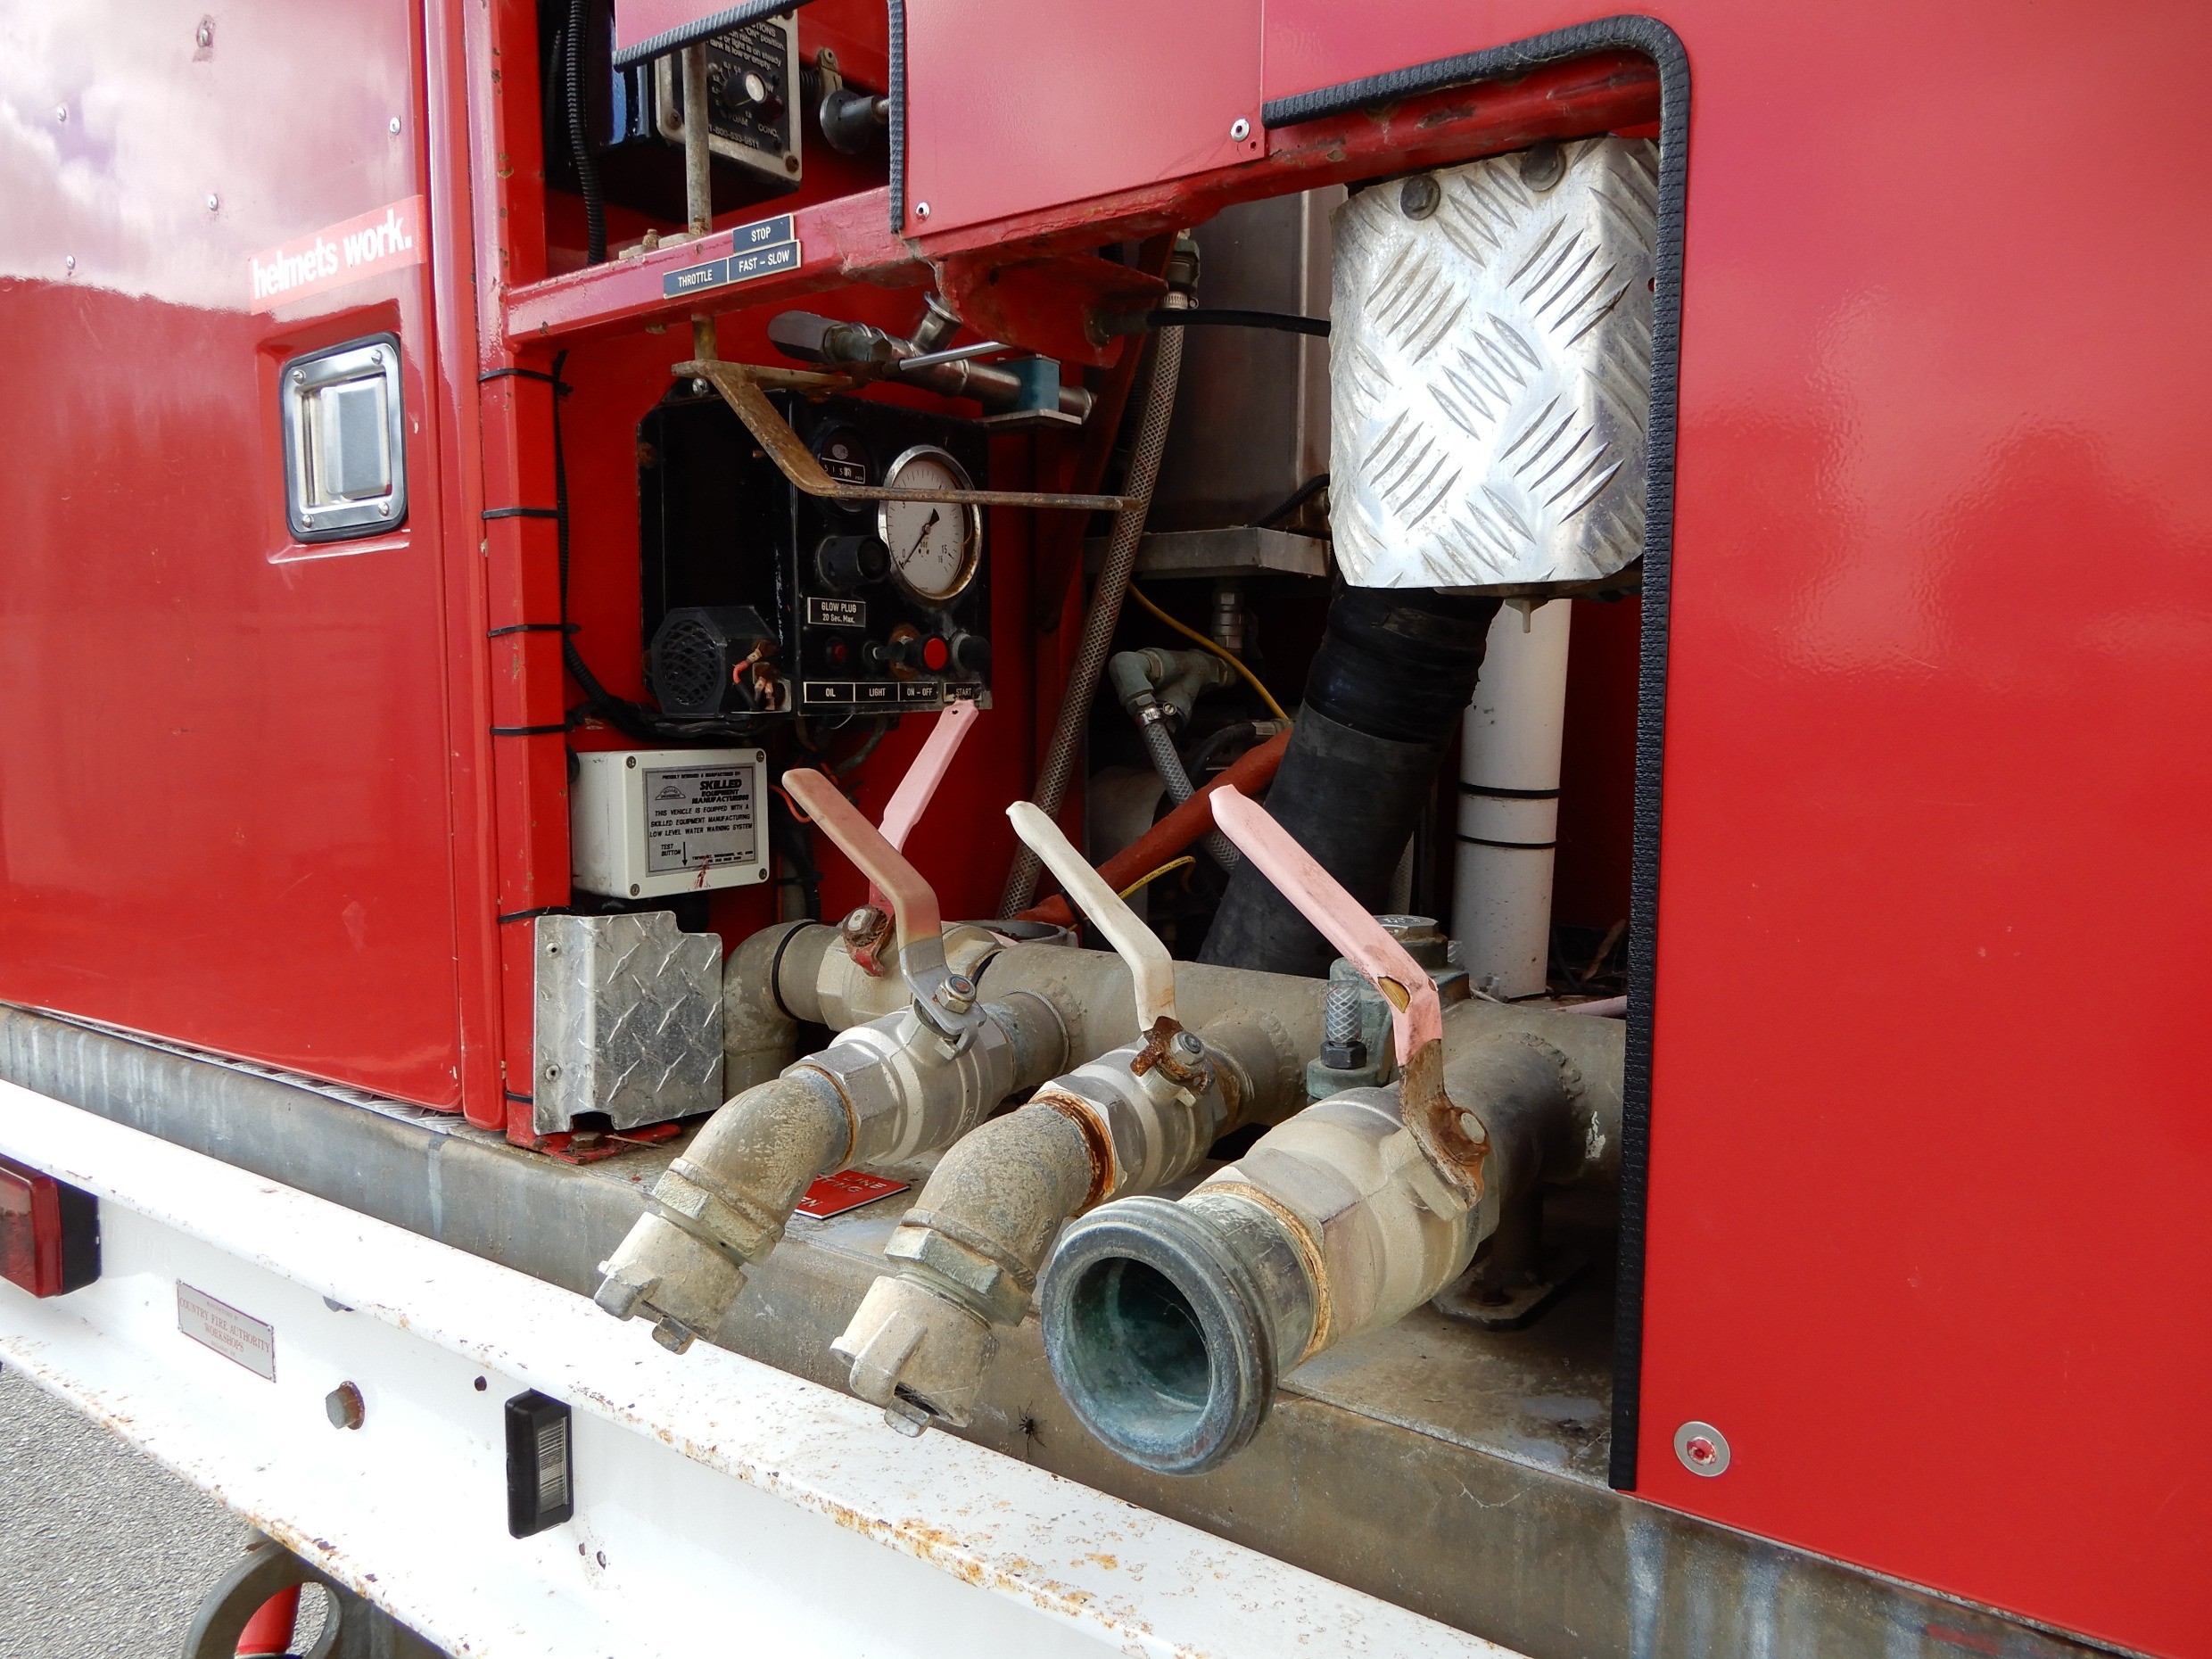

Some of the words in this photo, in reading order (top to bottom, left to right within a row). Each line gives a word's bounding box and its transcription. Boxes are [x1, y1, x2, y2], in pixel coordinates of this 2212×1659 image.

[739, 34, 754, 45] rate.
[760, 34, 785, 52] position.
[710, 38, 723, 50] tank
[724, 44, 730, 53] is
[731, 46, 743, 58] low
[743, 53, 751, 61] or
[751, 56, 772, 71] empty.
[723, 35, 730, 43] or
[731, 37, 745, 51] light
[746, 44, 752, 53] is
[753, 48, 761, 56] on
[762, 52, 781, 68] steady
[750, 227, 772, 243] STOP
[252, 237, 339, 300] helmets
[343, 209, 413, 268] work.
[739, 258, 758, 273] FAST
[767, 250, 790, 266] SLOW
[678, 269, 713, 288] THROTTLE
[902, 549, 906, 558] 0
[941, 544, 948, 554] 15
[821, 601, 839, 613] GLOW
[840, 603, 857, 614] PLUG
[821, 613, 830, 622] 20
[830, 614, 842, 623] Sec.
[842, 615, 855, 623] Max.
[825, 688, 837, 697] OIL
[869, 688, 887, 697] LIGHT
[906, 688, 915, 697] ON
[921, 688, 933, 697] OFF
[955, 688, 972, 697] START
[699, 779, 742, 791] SKILLED
[701, 788, 739, 797] EQUIPMENT
[691, 795, 749, 805] MANUFACTURING
[650, 820, 673, 828] SKILLED
[675, 817, 706, 826] EQUIPMENT
[707, 813, 751, 823] MANUFACTURING
[649, 830, 663, 838] LOW
[664, 829, 681, 837] LEVEL
[685, 827, 704, 835] WATER
[732, 822, 753, 831] SYSTEM
[842, 1176, 887, 1189] LINE
[179, 1297, 210, 1321] COUNTRY
[211, 1314, 227, 1331] FIRE
[229, 1325, 270, 1353] AUTHORITY
[204, 1323, 244, 1352] WORKSHOPS
